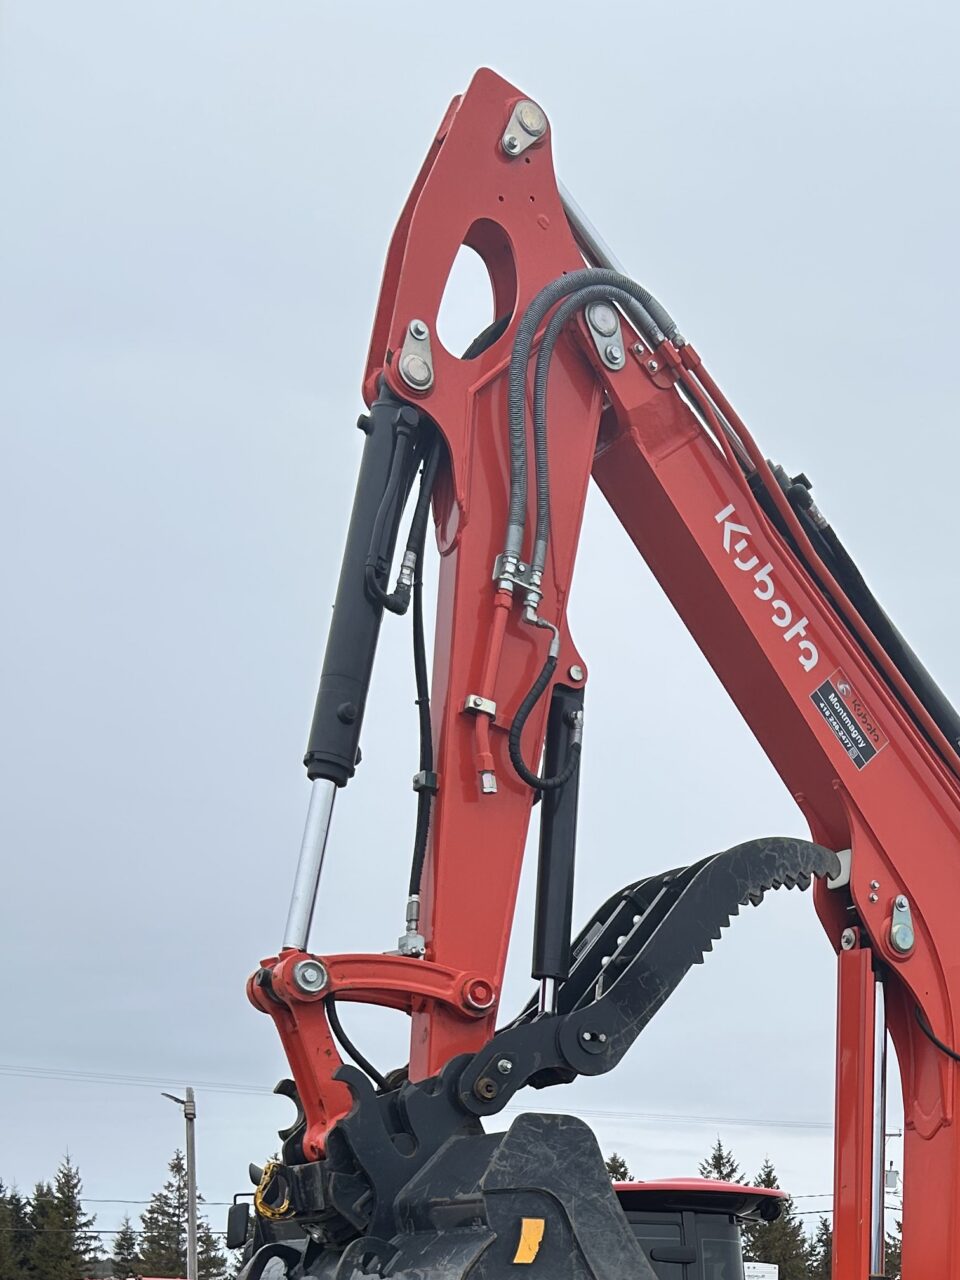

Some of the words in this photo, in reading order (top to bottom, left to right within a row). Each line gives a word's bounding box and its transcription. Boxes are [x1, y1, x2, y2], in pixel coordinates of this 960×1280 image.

[714, 503, 819, 673] Kubota
[819, 702, 830, 716] 418
[828, 693, 866, 748] Montmagny
[852, 699, 880, 743] Kubota
